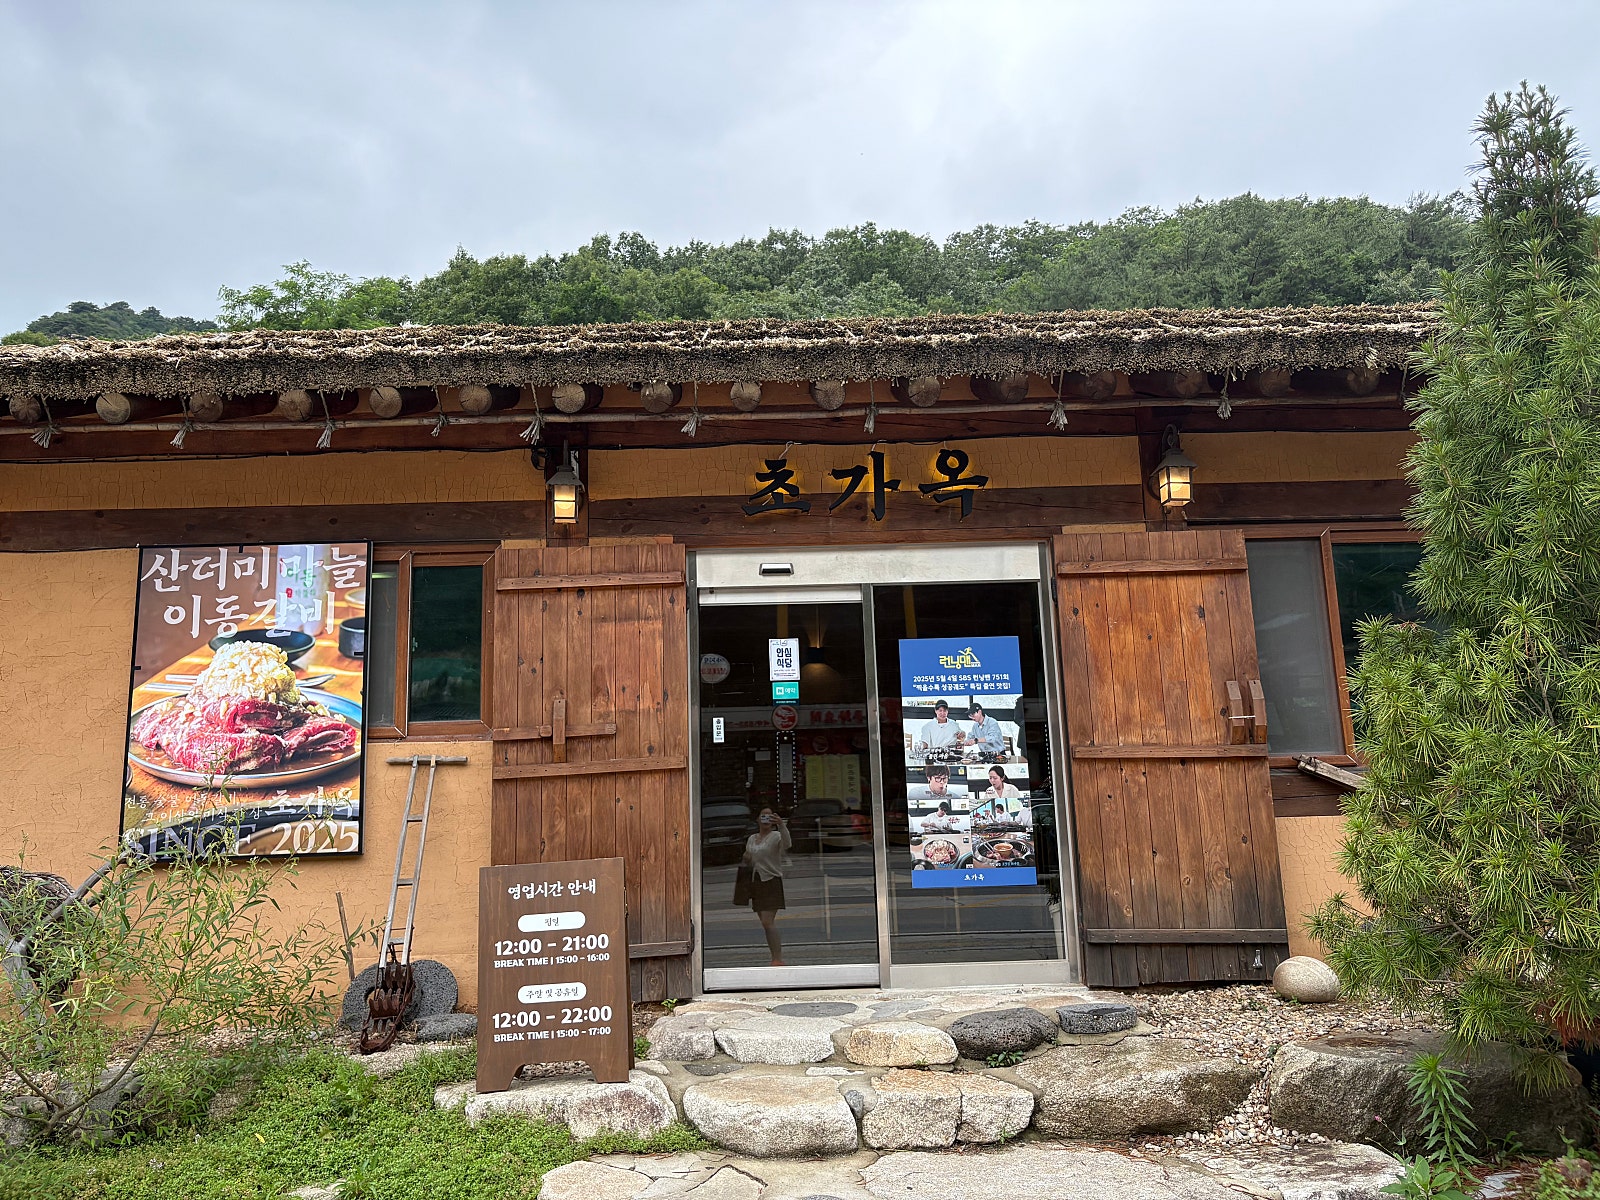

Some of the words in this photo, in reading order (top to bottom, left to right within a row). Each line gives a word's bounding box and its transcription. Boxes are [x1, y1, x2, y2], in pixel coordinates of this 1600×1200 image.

[741, 449, 989, 522] 초가옥
[141, 546, 271, 592] 산더미
[279, 544, 367, 589] 마늘
[163, 590, 335, 638] 이동갈비
[776, 647, 792, 658] 안심
[776, 658, 792, 668] 식당
[939, 654, 971, 669] 런닝맨
[913, 675, 935, 683] 2025년
[936, 674, 946, 682] 5월
[972, 673, 991, 682] 런닝맨
[272, 820, 359, 855] 2025
[508, 881, 564, 900] 영업시간
[568, 878, 596, 896] 안내
[544, 917, 559, 927] 평일
[494, 938, 542, 956] 12:00
[562, 933, 609, 952] 21:00
[494, 958, 525, 968] BREAK
[526, 957, 549, 966] TIME
[556, 955, 578, 964] 15:00
[587, 952, 610, 962] 16:00
[526, 989, 543, 999] 주말
[545, 988, 553, 998] 및
[554, 986, 579, 997] 공휴일
[492, 1010, 540, 1028] 12:00
[561, 1005, 612, 1024] 22:00
[493, 1032, 525, 1043] BREAK
[526, 1030, 549, 1040] TIME
[556, 1028, 579, 1038] 15:00
[588, 1026, 611, 1036] 17:00
